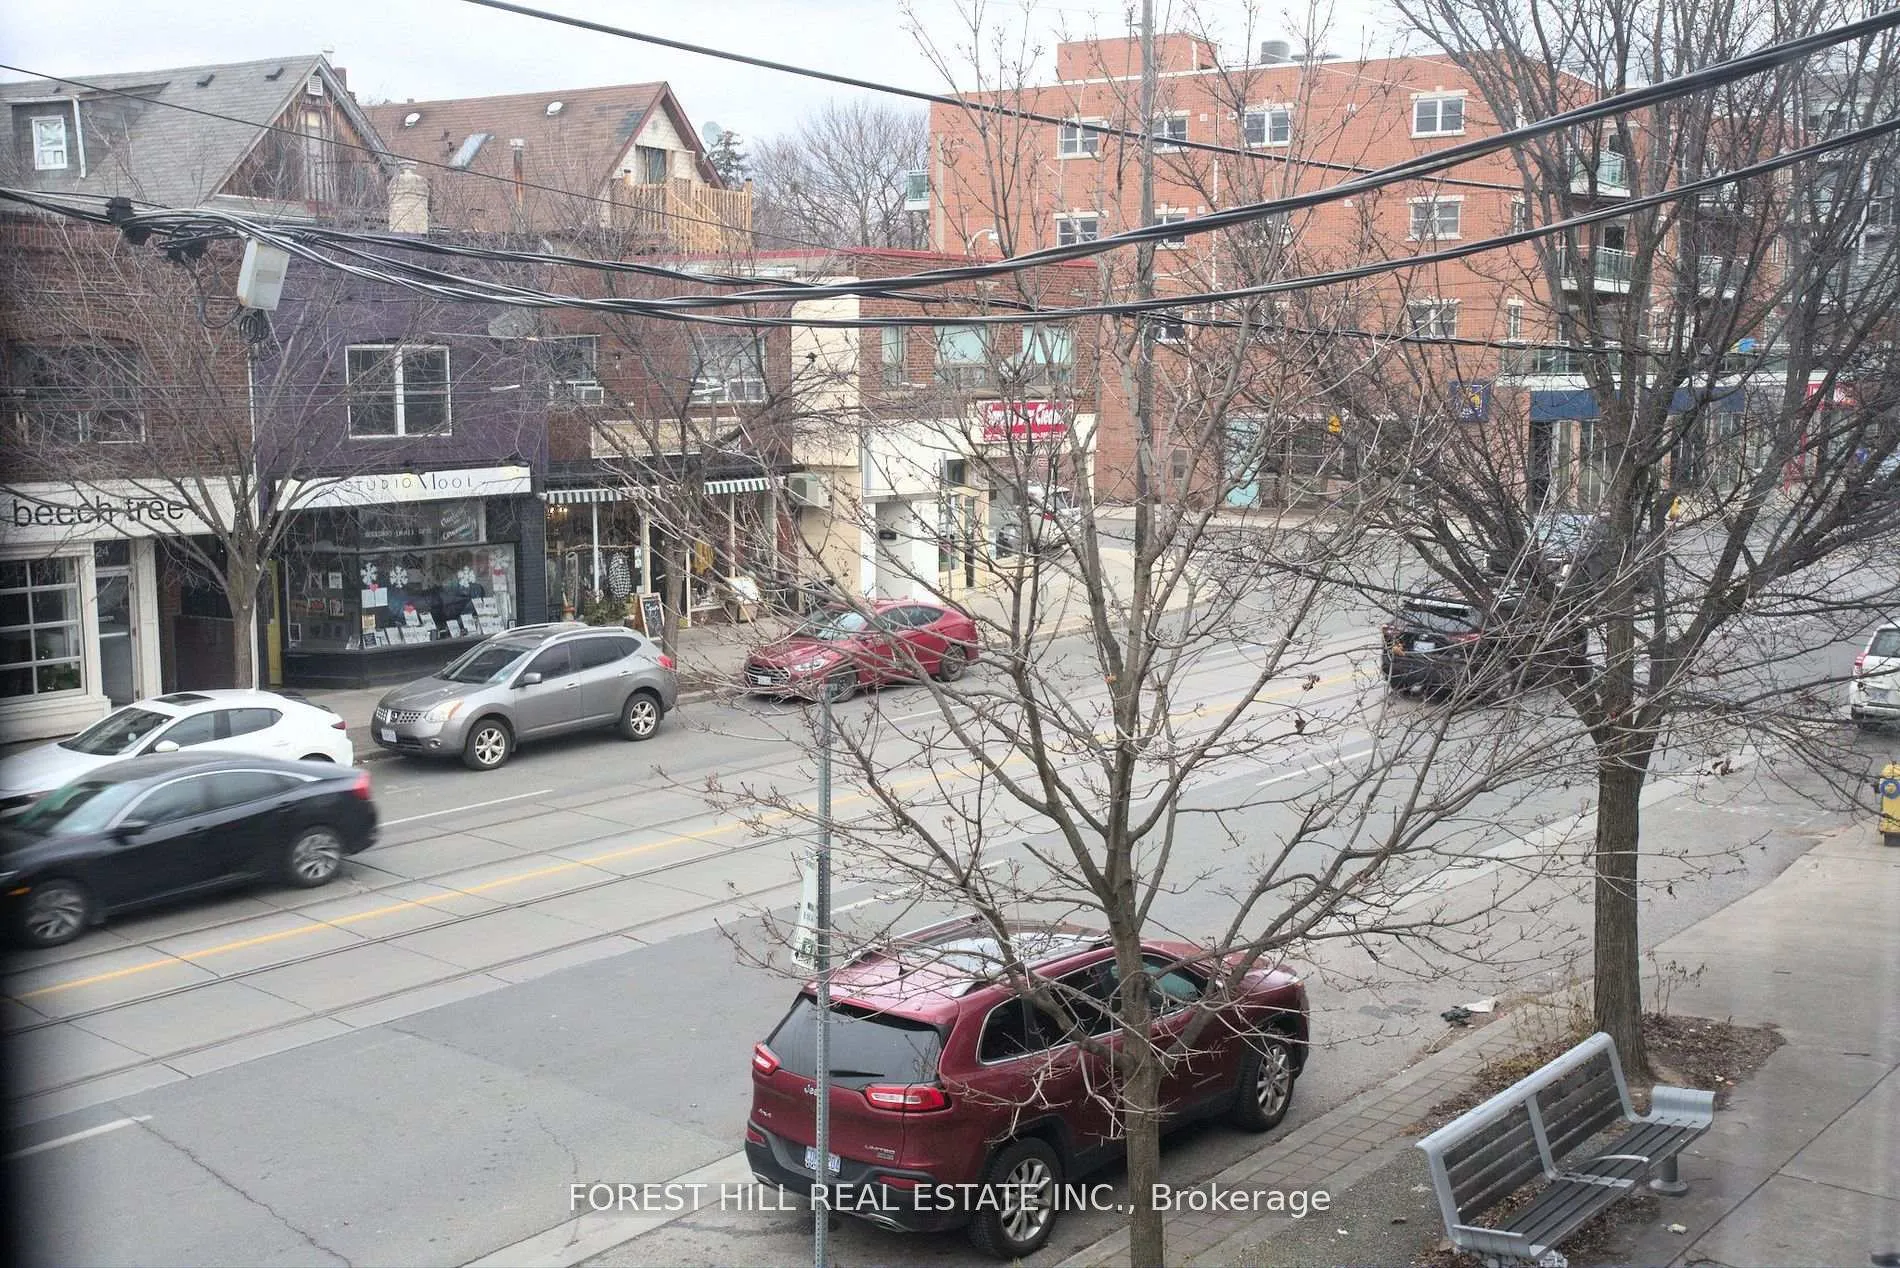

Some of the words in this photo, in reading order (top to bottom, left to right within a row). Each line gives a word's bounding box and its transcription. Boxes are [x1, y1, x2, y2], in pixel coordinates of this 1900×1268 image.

[345, 477, 412, 491] STUDIO
[13, 496, 113, 527] beech
[126, 498, 184, 521] tree
